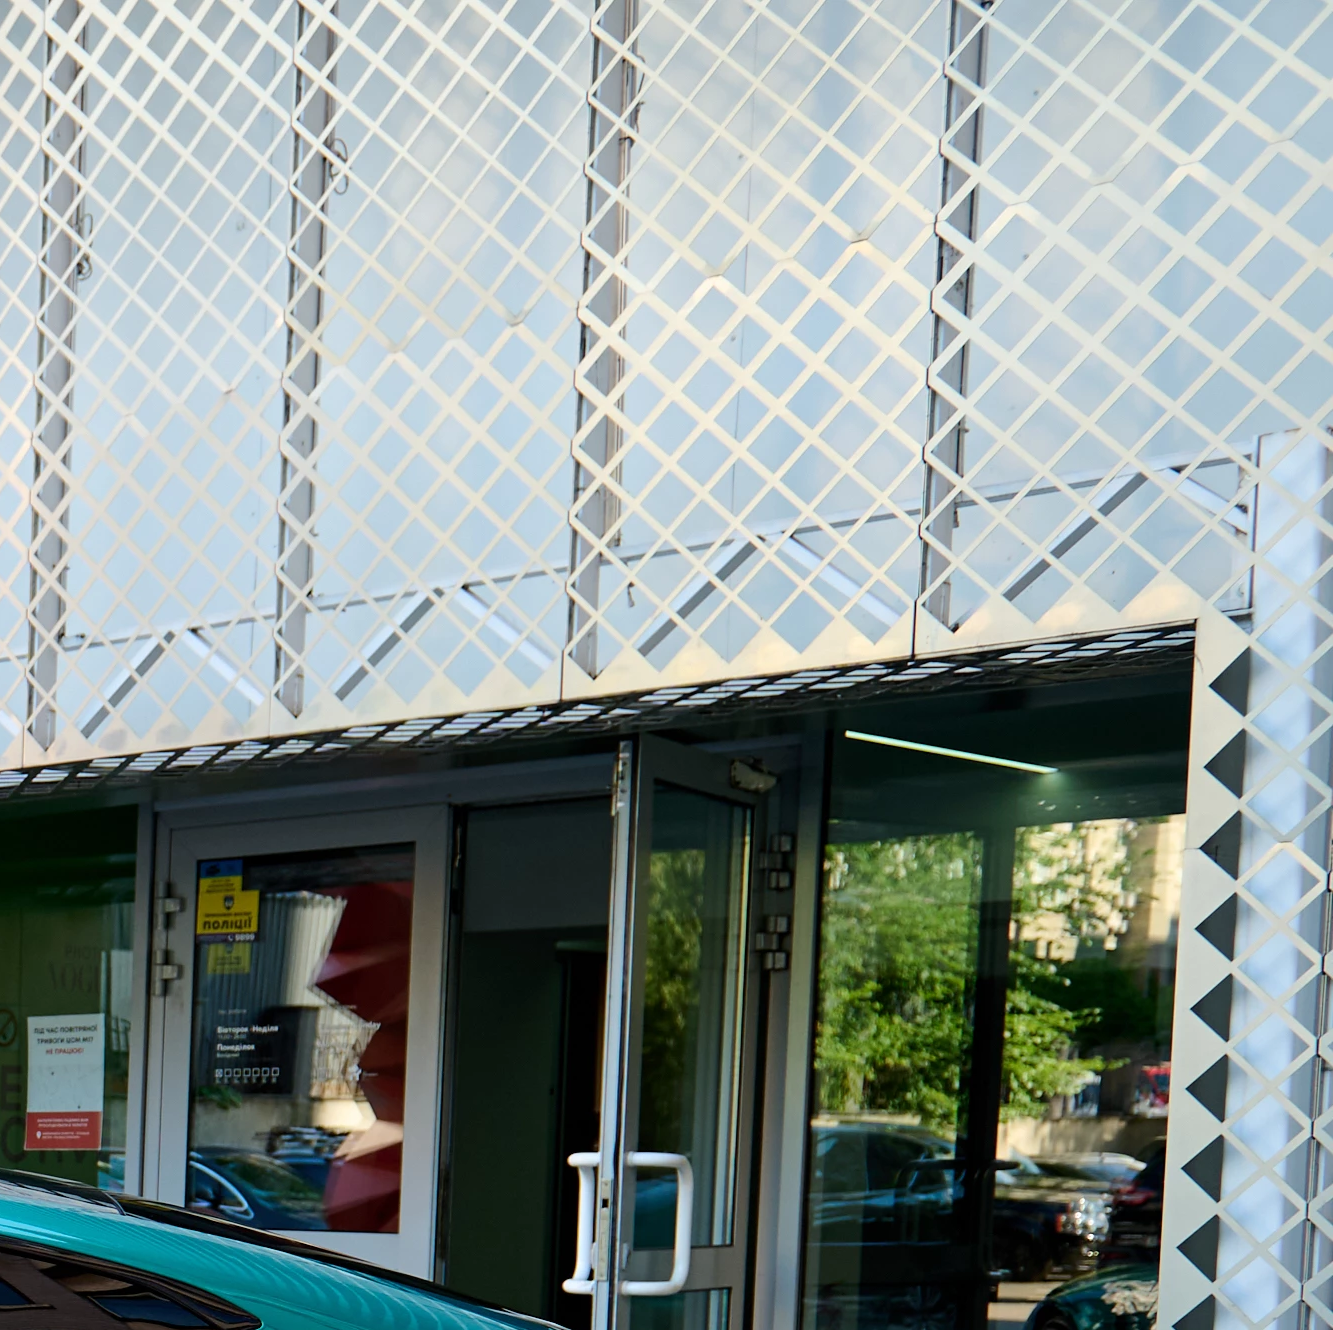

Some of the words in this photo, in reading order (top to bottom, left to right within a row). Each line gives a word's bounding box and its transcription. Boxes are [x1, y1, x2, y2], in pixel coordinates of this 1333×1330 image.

[65, 945, 101, 961] PHOT
[46, 1026, 59, 1034] ЧАС
[217, 1043, 255, 1052] Понеділок
